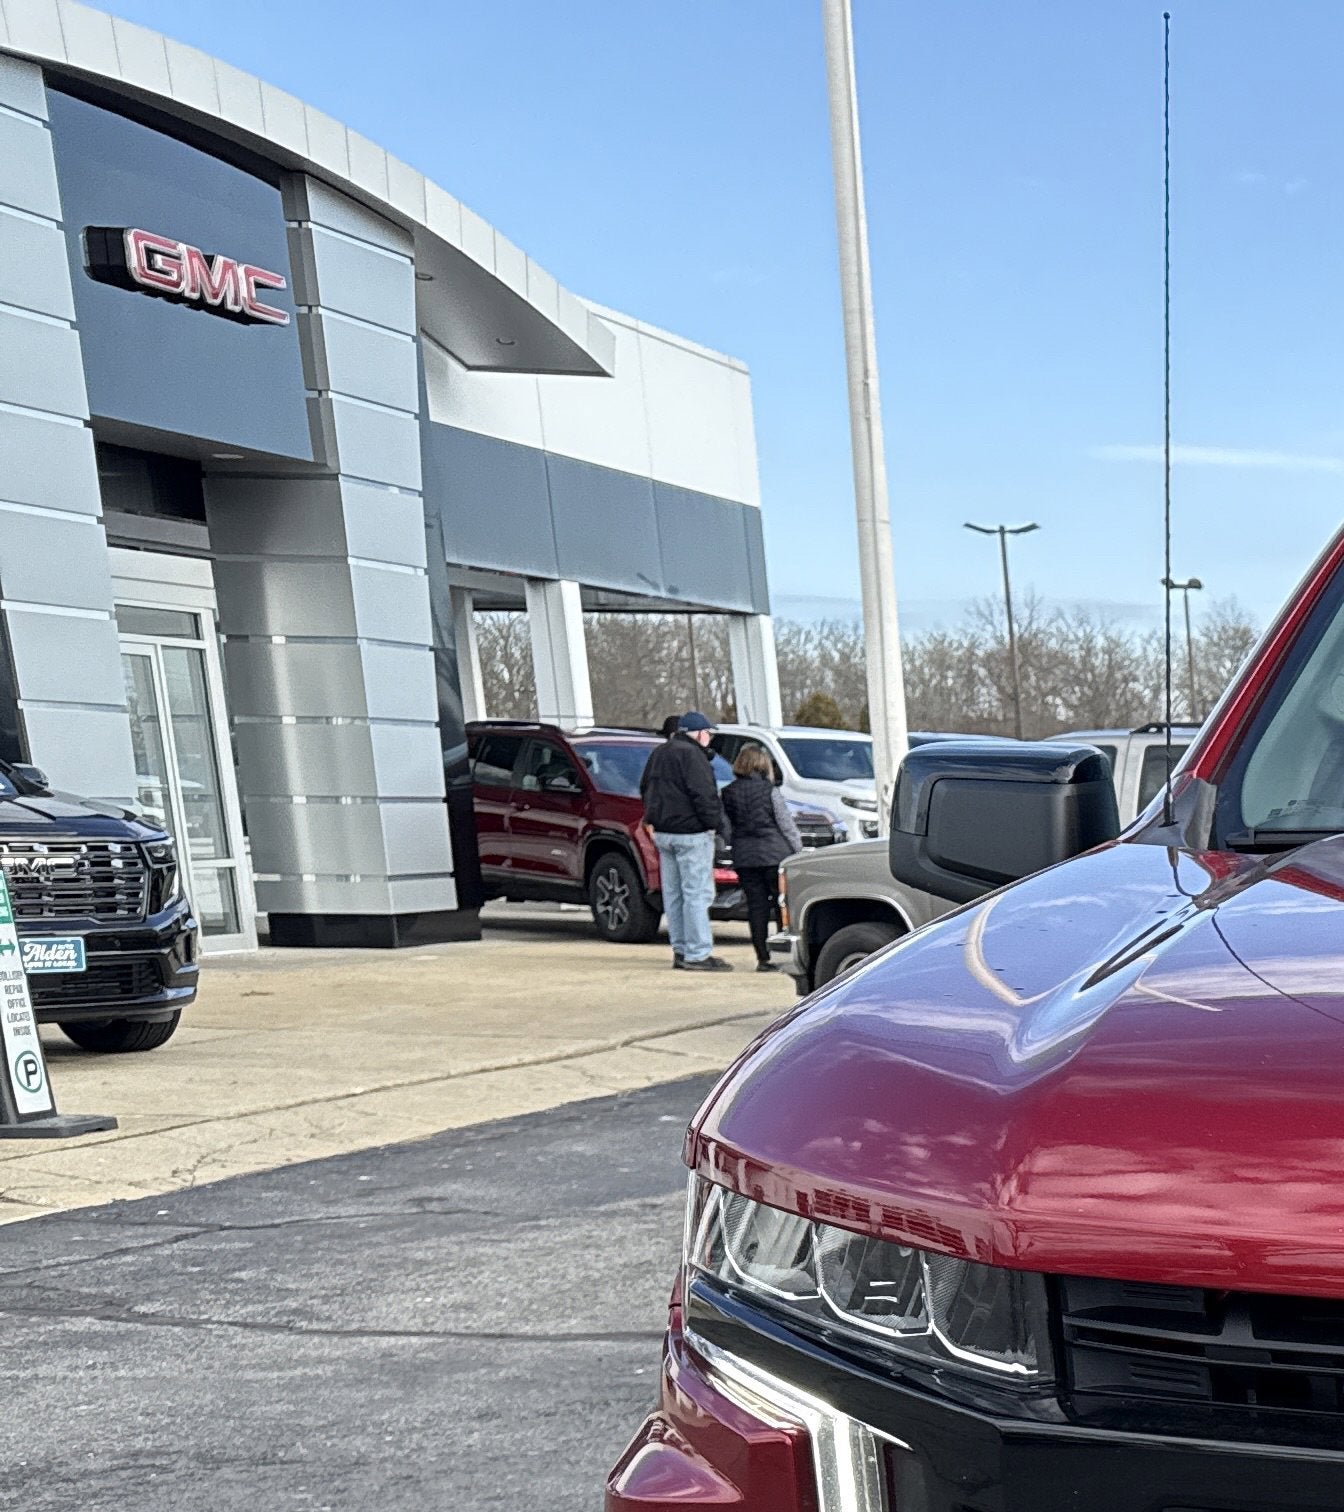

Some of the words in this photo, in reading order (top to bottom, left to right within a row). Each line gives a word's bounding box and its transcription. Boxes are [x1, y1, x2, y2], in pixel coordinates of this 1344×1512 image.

[124, 229, 290, 325] GMC
[22, 943, 78, 961] Alden
[23, 1058, 38, 1088] P
